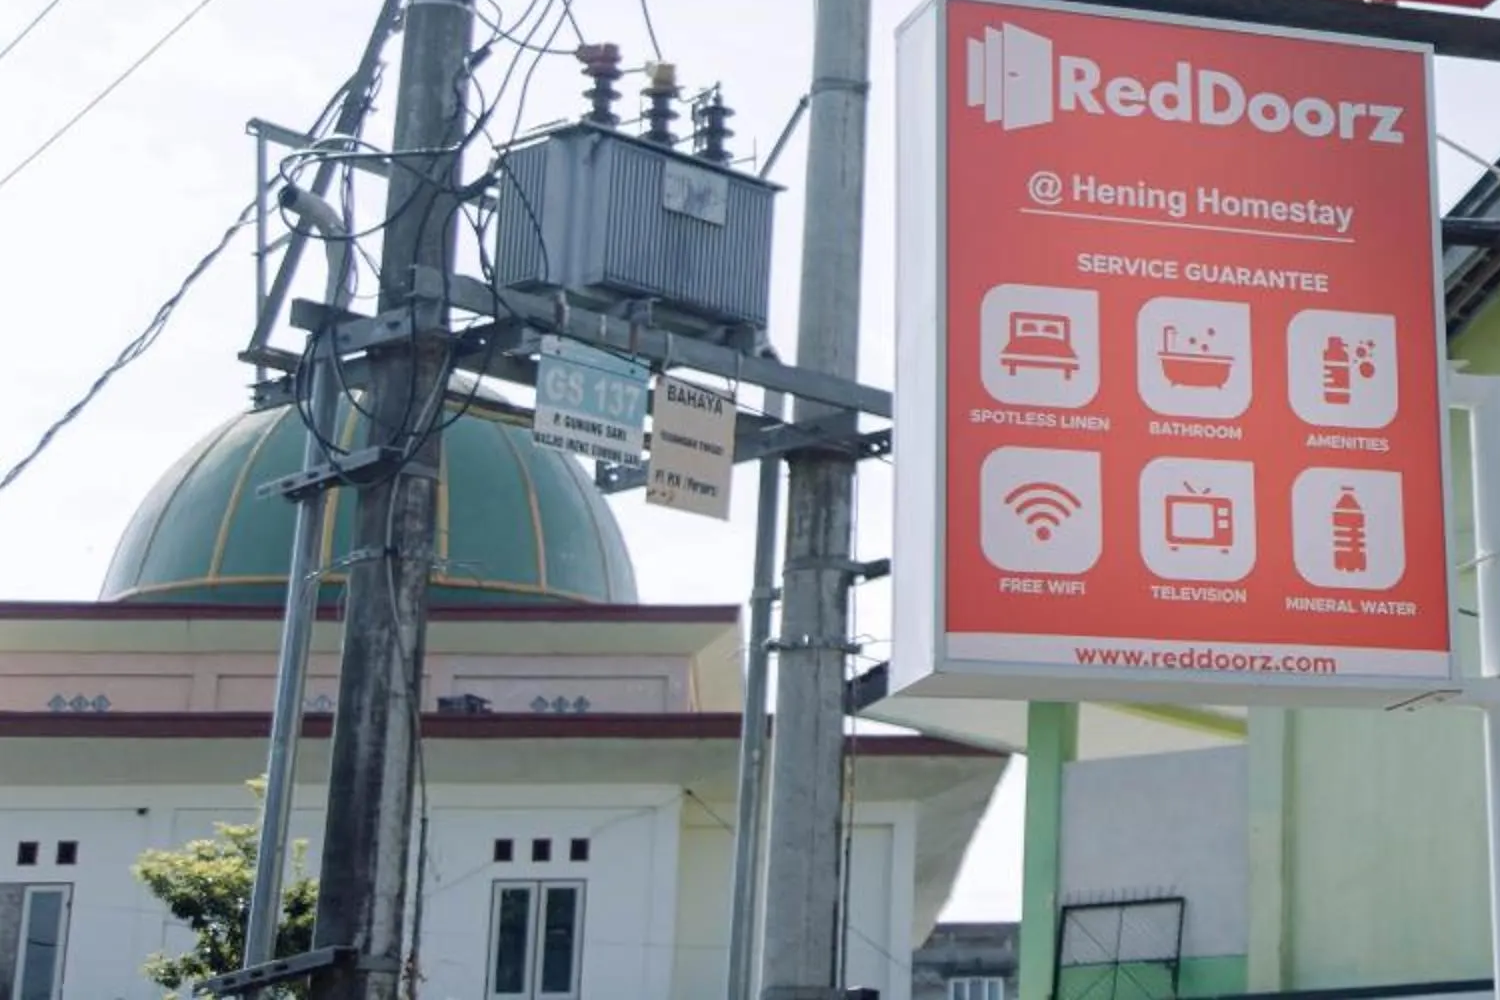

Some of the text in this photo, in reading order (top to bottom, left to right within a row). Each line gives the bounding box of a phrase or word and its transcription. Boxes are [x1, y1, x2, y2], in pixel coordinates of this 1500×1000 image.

[1059, 55, 1404, 144] RedDoorz
[1028, 171, 1354, 233] @ Hening Homestay
[1077, 252, 1330, 293] SERVICE GUARANTEE
[546, 366, 641, 418] GS 137
[667, 384, 723, 415] BAHAYA
[969, 408, 1111, 432] SPOTLESS LINEN
[1149, 420, 1243, 441] BATHROOM
[1305, 432, 1390, 453] AMENITIES
[1000, 577, 1087, 596] FREE WIFI
[1151, 585, 1247, 604] TELEVISION
[1285, 597, 1417, 617] MINERAL WATER
[1074, 645, 1337, 674] www.reddoorz.com
